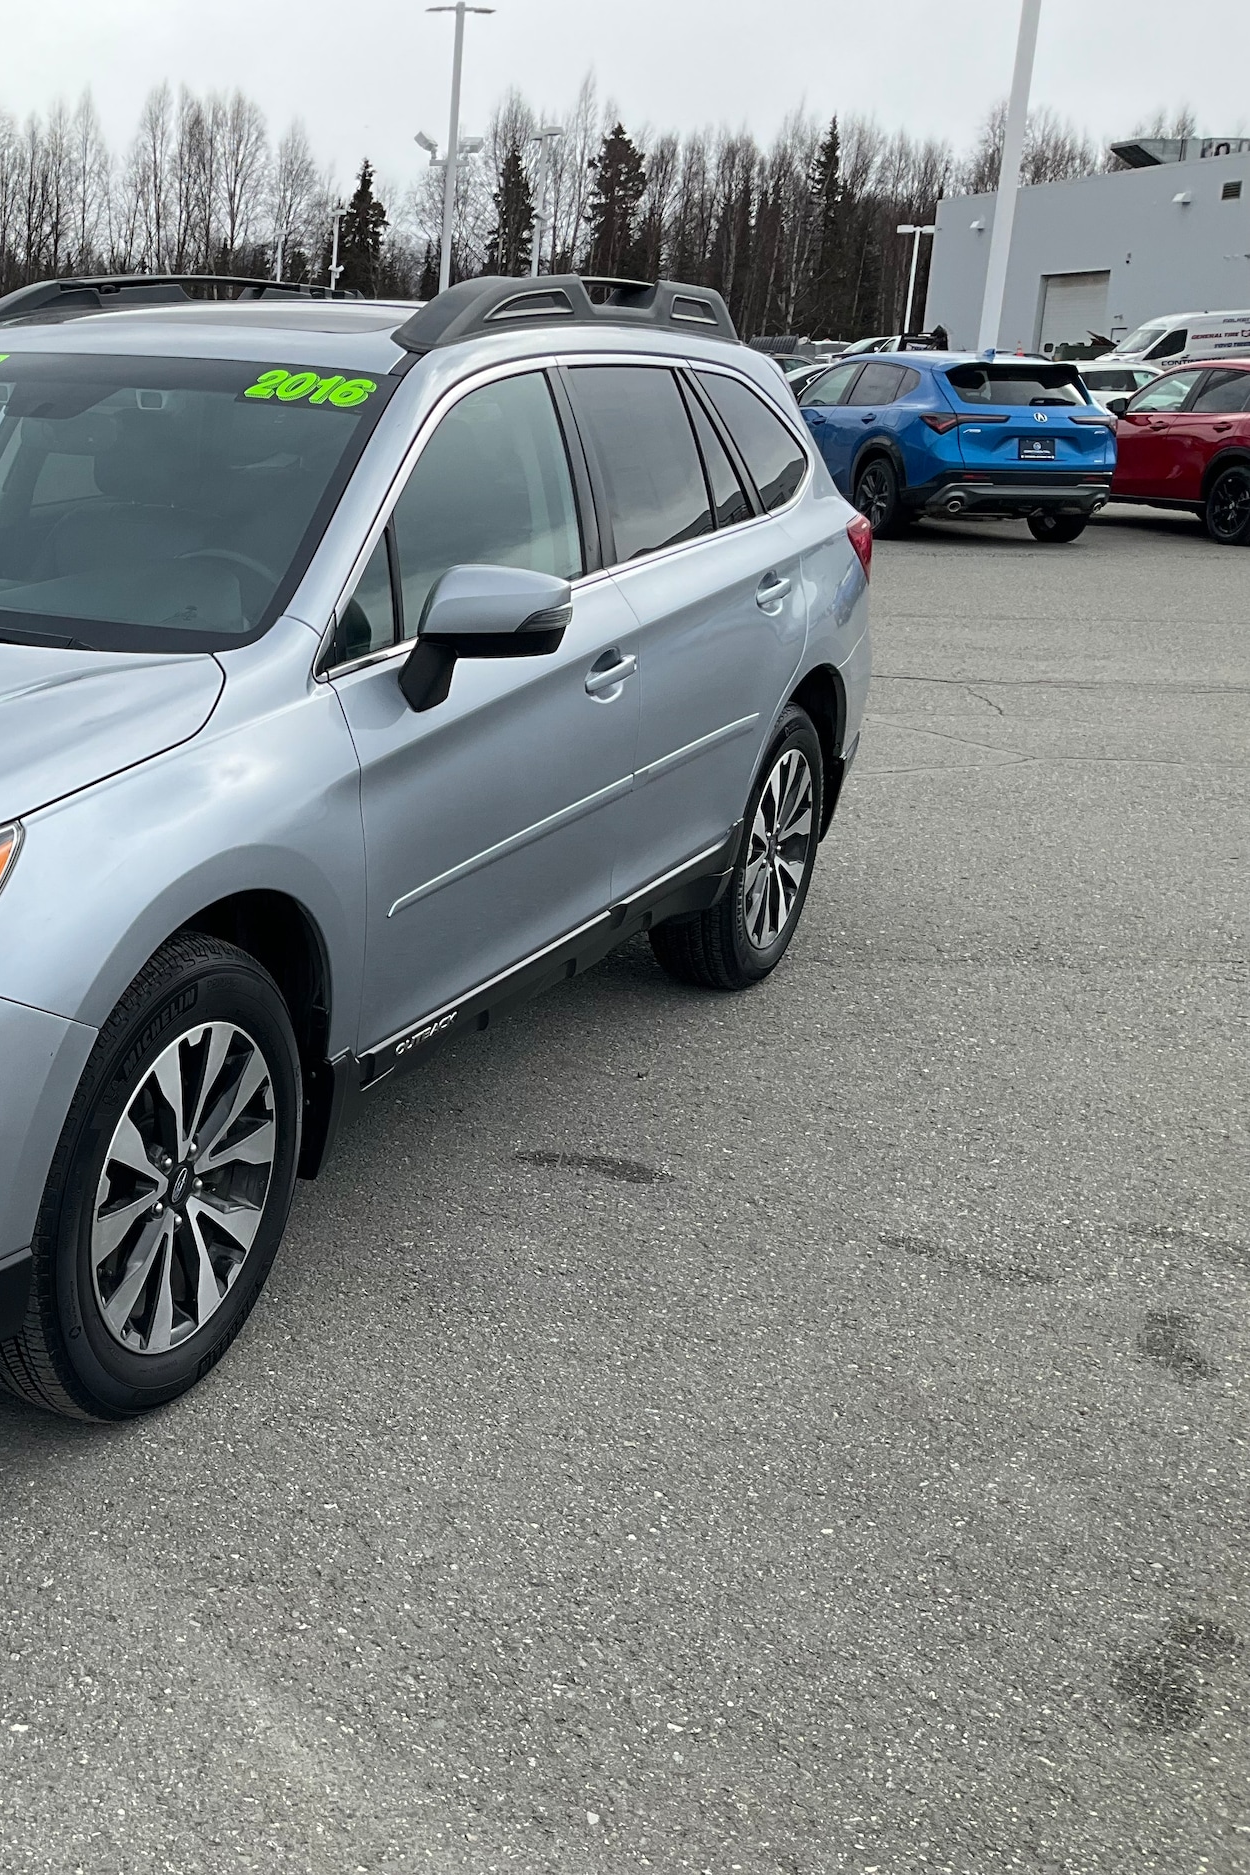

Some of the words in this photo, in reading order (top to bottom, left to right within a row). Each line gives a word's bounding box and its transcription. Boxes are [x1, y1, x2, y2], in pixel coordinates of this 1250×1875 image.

[243, 369, 377, 408] 2016
[123, 988, 196, 1078] MICHELIN
[394, 1011, 458, 1056] OUTBACK
